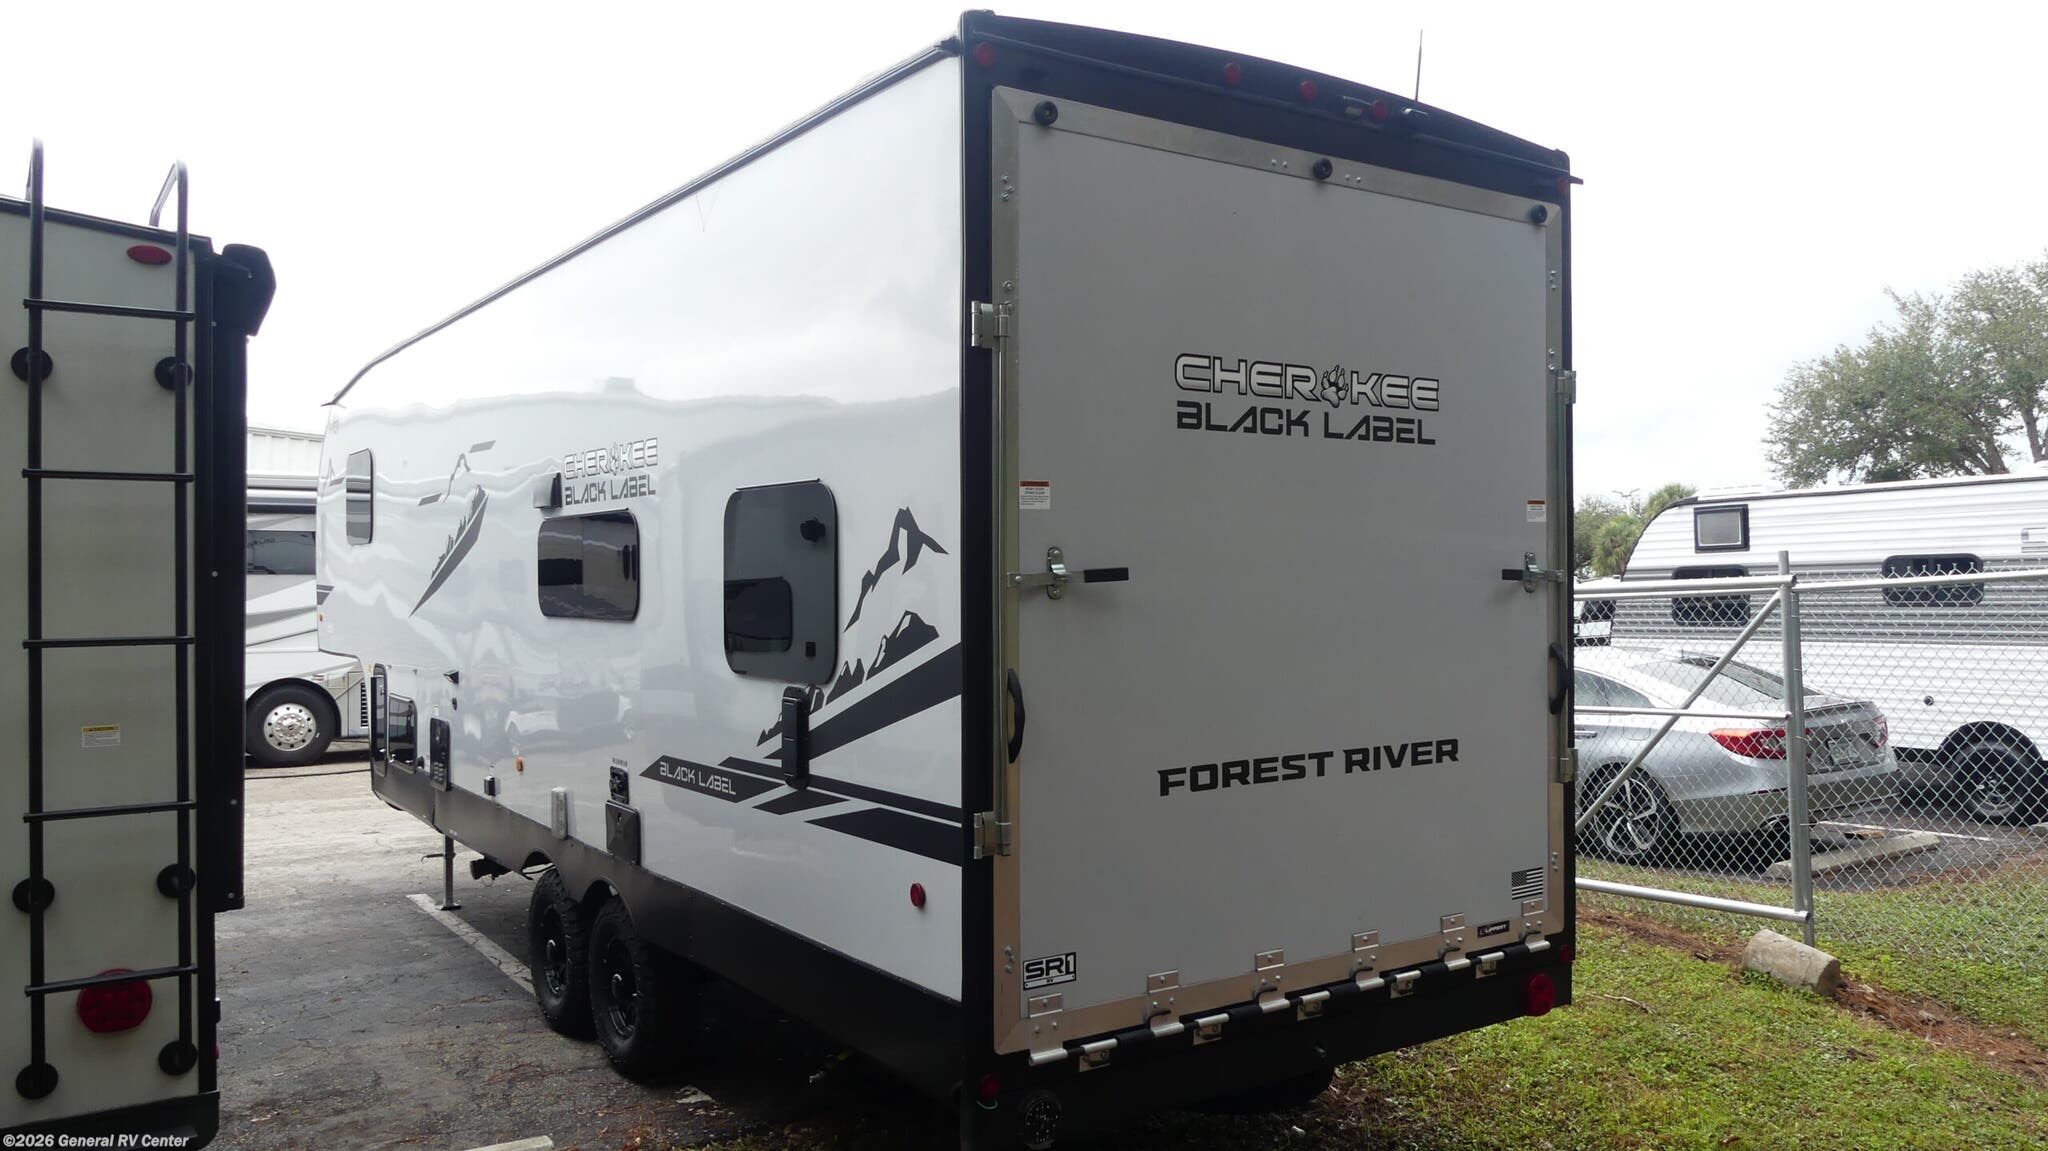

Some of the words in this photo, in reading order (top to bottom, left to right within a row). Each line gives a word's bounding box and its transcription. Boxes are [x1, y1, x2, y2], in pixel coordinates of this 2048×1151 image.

[1177, 401, 1310, 437] BLACK
[1324, 411, 1436, 445] LABEL
[565, 481, 606, 505] BLACK
[611, 474, 656, 500] LABEL
[659, 761, 695, 784] BLACK
[698, 770, 736, 795] LABEL
[1157, 751, 1334, 797] FOREST
[1343, 738, 1459, 774] RIVER
[1025, 954, 1075, 980] SR1
